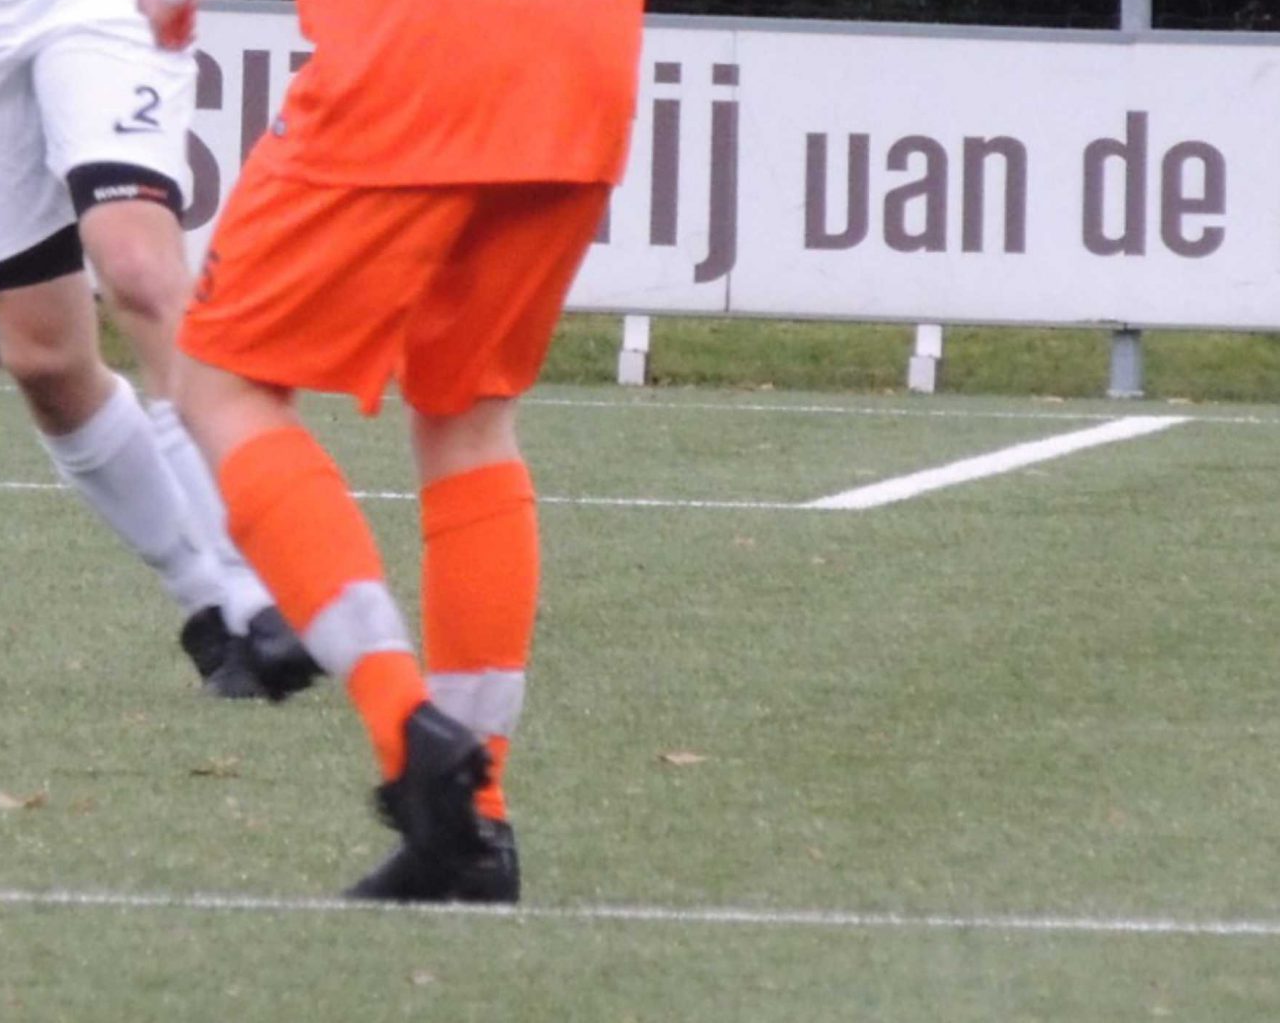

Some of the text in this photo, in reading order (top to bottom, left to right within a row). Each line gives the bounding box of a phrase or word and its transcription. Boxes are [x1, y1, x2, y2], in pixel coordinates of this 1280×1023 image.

[133, 85, 160, 126] 2
[803, 132, 1028, 254] van
[1081, 110, 1227, 258] de
